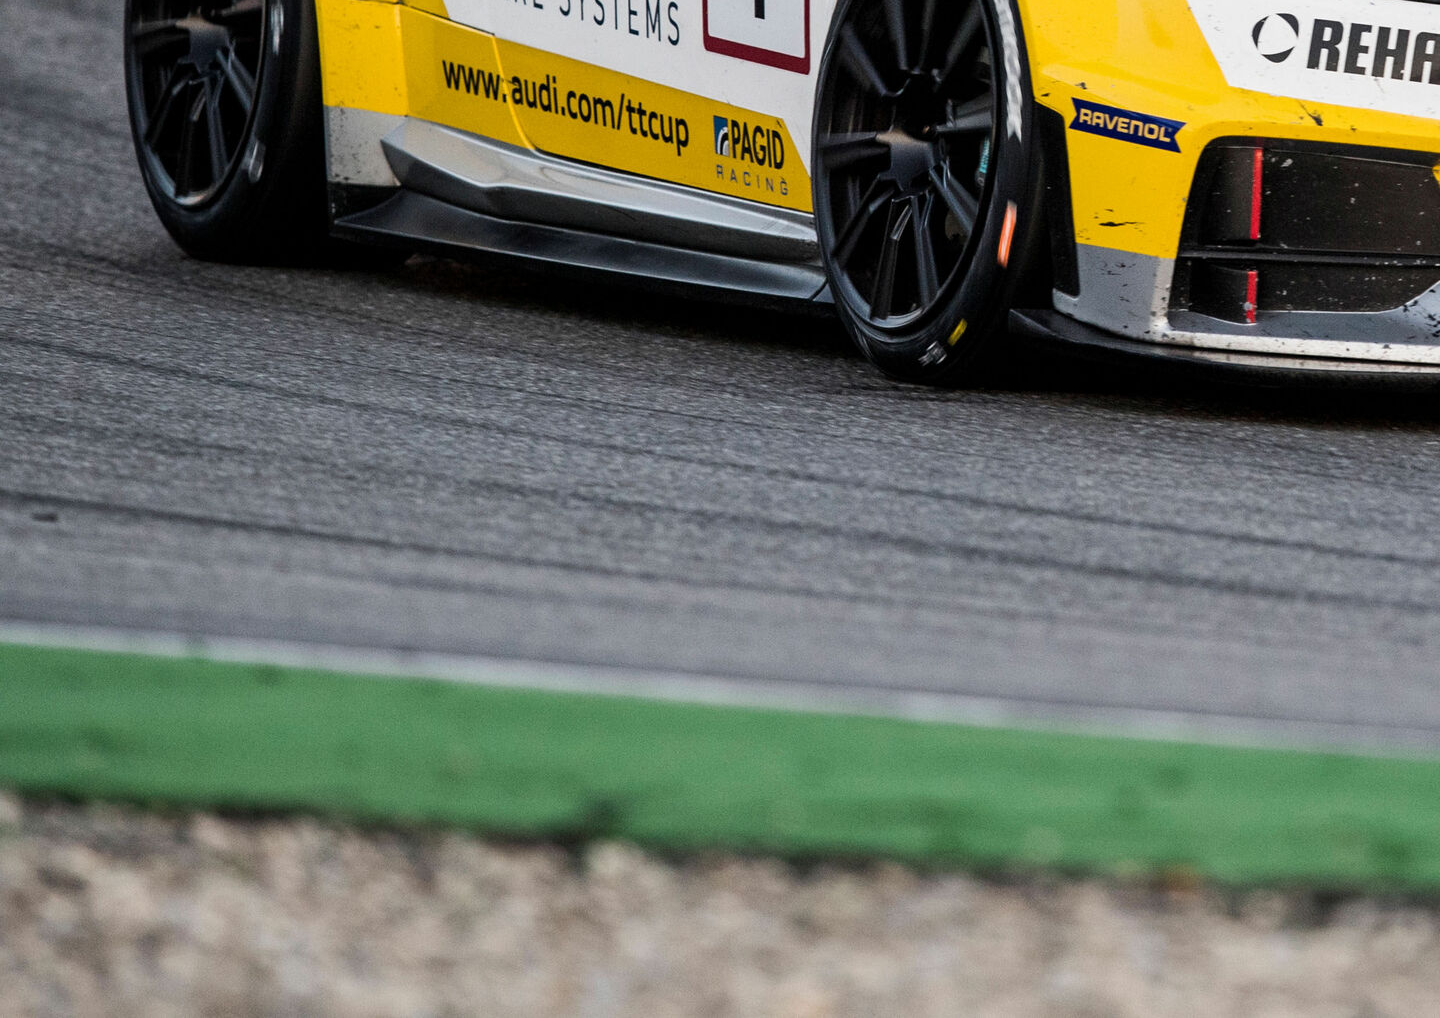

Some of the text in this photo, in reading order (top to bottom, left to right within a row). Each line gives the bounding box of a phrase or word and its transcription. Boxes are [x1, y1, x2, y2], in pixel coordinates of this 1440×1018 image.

[442, 59, 690, 158] www.audi.com/ttcup
[1079, 108, 1172, 143] RAVENOL
[730, 119, 785, 170] PAGID
[716, 164, 789, 196] RACING
